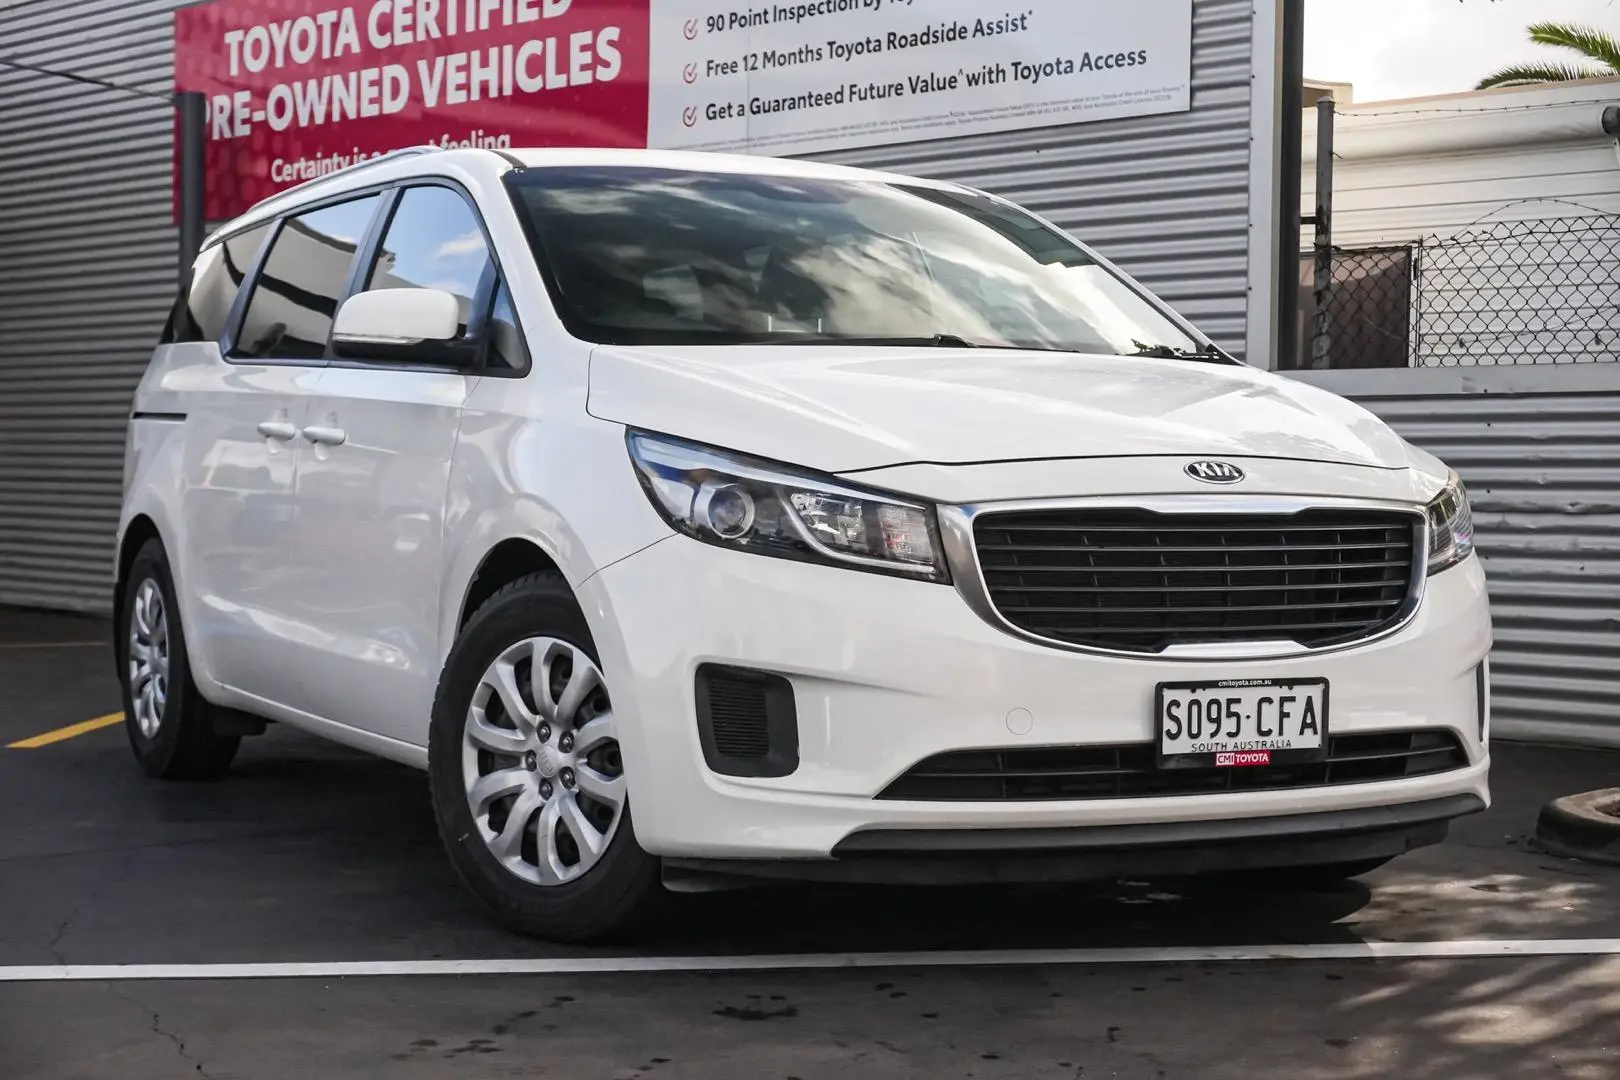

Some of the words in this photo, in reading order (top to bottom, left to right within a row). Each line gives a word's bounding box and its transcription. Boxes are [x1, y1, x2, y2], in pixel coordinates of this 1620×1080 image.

[706, 14, 725, 33] 90
[729, 8, 769, 30] Point
[773, 0, 859, 30] Inspection
[223, 10, 361, 76] TOYOTA
[706, 59, 738, 77] Free
[743, 54, 759, 71] 12
[762, 43, 823, 69] Months
[827, 37, 882, 61] Toyota
[887, 21, 968, 51] Roadside
[205, 64, 409, 140] RE-OWNED
[417, 27, 621, 108] VEHICLES
[706, 103, 733, 120] Get
[736, 103, 745, 117] a
[750, 85, 844, 115] Guaranteed
[849, 80, 904, 103] Future
[966, 63, 1006, 87] with
[1011, 57, 1074, 84] Toyota
[1079, 49, 1147, 73] Access
[1194, 462, 1239, 477] KIA
[1218, 679, 1272, 688] cmitoyota.com.au
[1191, 741, 1227, 752] SOUTH
[1233, 739, 1292, 750] AUSTRALIA
[1217, 754, 1234, 764] CMI
[1236, 752, 1269, 763] TOYOTA
